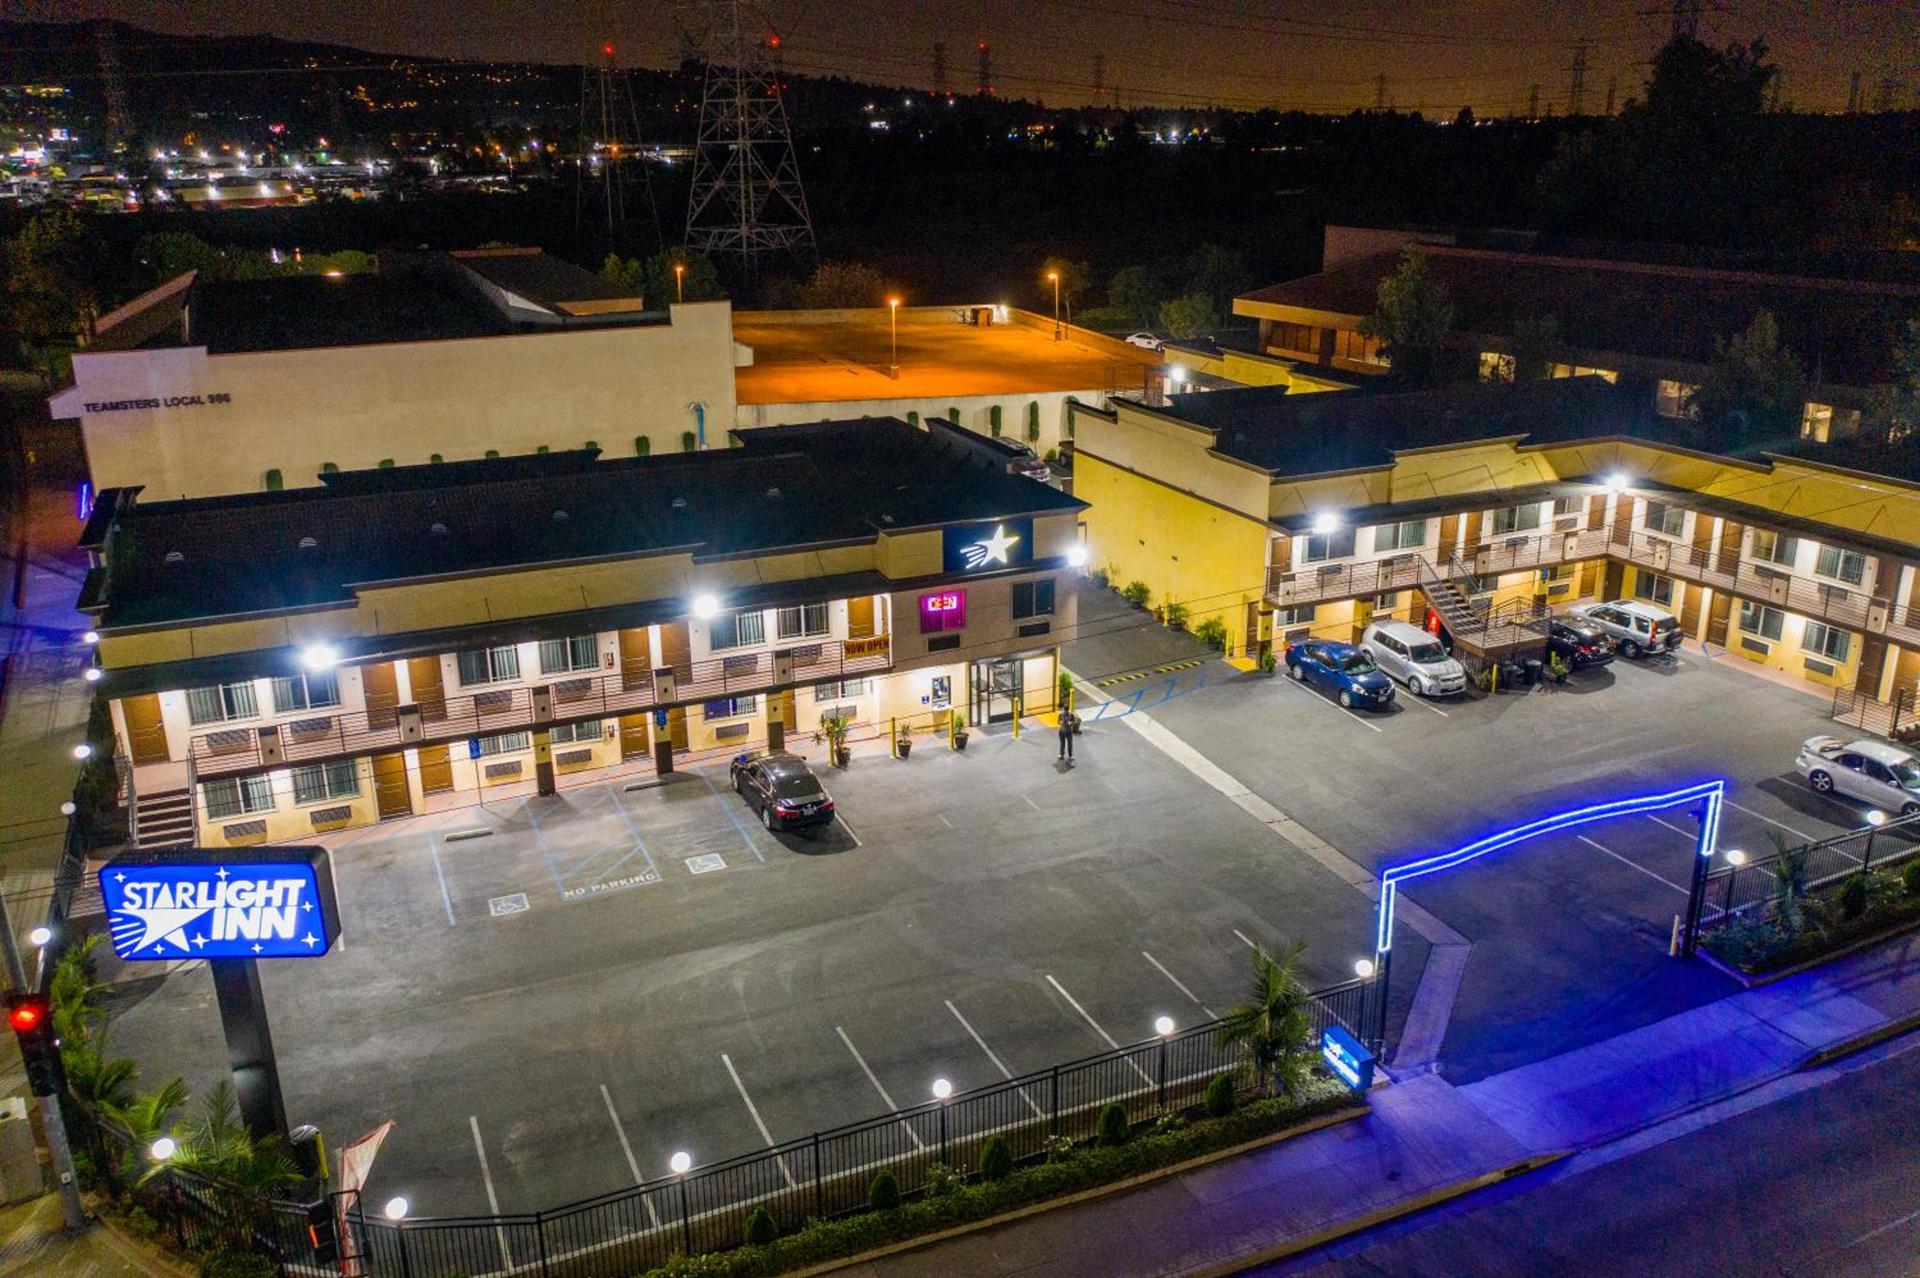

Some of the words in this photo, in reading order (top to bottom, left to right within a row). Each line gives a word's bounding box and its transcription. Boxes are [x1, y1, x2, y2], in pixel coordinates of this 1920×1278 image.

[83, 398, 160, 413] TEAMSTERS
[163, 395, 206, 408] LOCAL
[122, 879, 306, 909] STARLIGHT
[563, 887, 586, 898] NO
[591, 872, 656, 892] PARKING
[211, 907, 298, 940] INN
